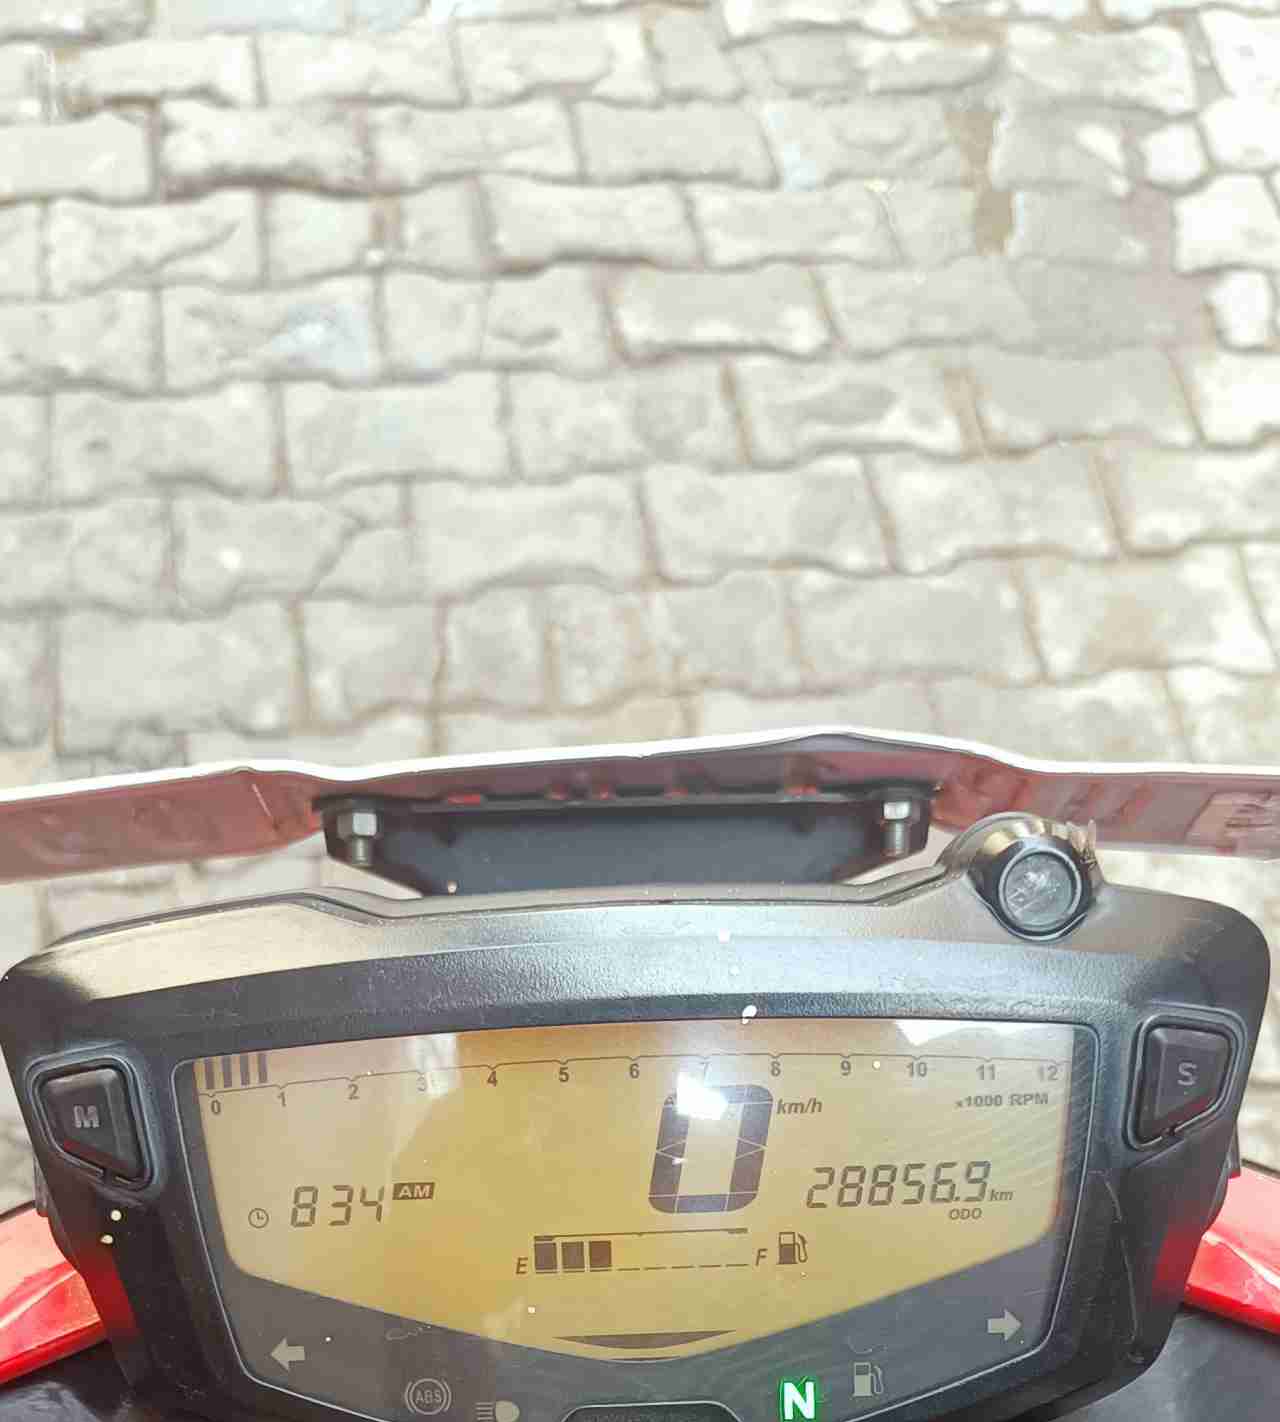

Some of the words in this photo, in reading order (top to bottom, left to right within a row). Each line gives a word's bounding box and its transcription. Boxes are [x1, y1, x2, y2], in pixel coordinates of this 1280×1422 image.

[1177, 1062, 1198, 1086] S
[210, 1100, 221, 1115] 0
[277, 1092, 287, 1107] 1
[348, 1084, 360, 1100] 2
[416, 1076, 428, 1092] 3
[487, 1071, 498, 1087] 4
[559, 1067, 569, 1083] 5
[629, 1063, 640, 1079] 6
[770, 1061, 781, 1077] 8
[840, 1061, 851, 1077] 9
[905, 1062, 927, 1077] 10
[976, 1064, 996, 1081] 11
[1038, 1066, 1058, 1082] 12
[776, 1099, 823, 1115] km/h
[955, 1094, 1003, 1109] x1000
[1010, 1092, 1049, 1107] RPM
[73, 1105, 100, 1129] M
[648, 1083, 774, 1214] 0
[397, 1184, 433, 1200] AM
[989, 1188, 1014, 1202] km
[949, 1207, 982, 1221] ODO
[515, 1257, 528, 1275] E
[755, 1248, 768, 1267] F
[415, 1389, 442, 1405] ABS
[783, 1381, 816, 1420] N
